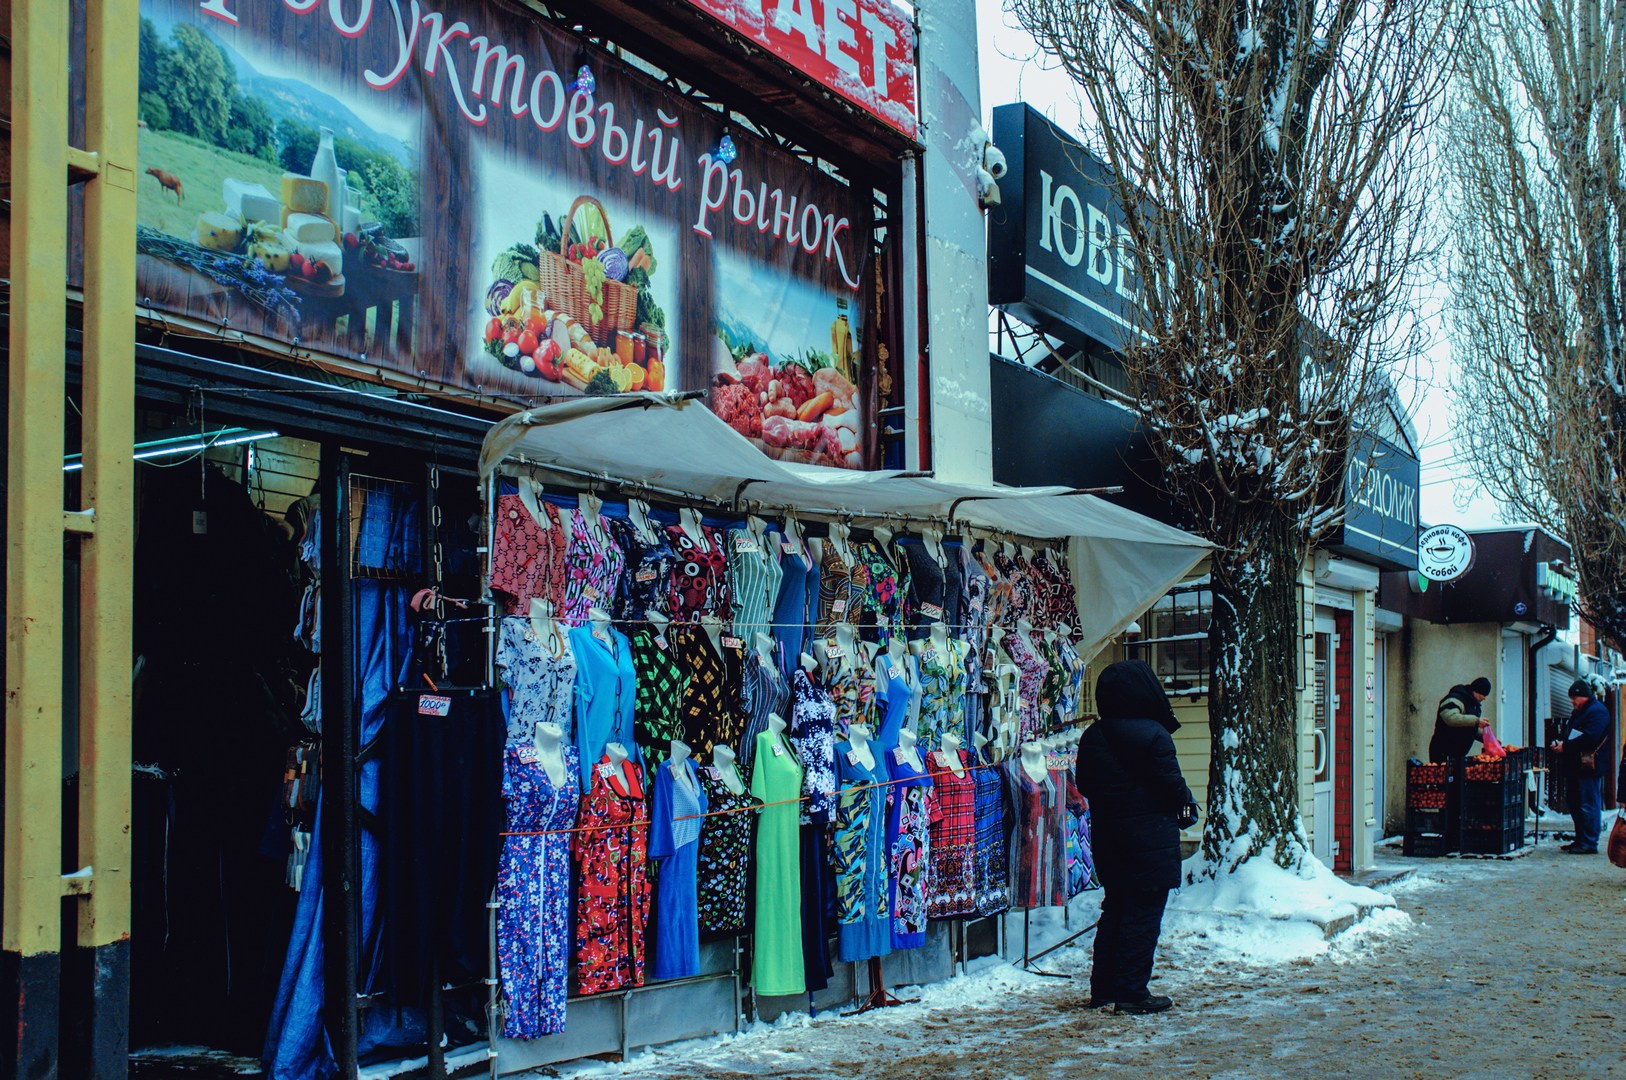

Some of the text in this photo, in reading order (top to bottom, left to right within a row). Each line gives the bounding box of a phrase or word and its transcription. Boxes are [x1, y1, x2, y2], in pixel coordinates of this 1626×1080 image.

[693, 151, 860, 291] рынок
[1348, 456, 1416, 527] СЕРДОЛИК
[1450, 530, 1467, 547] кофе
[1431, 563, 1458, 577] собой
